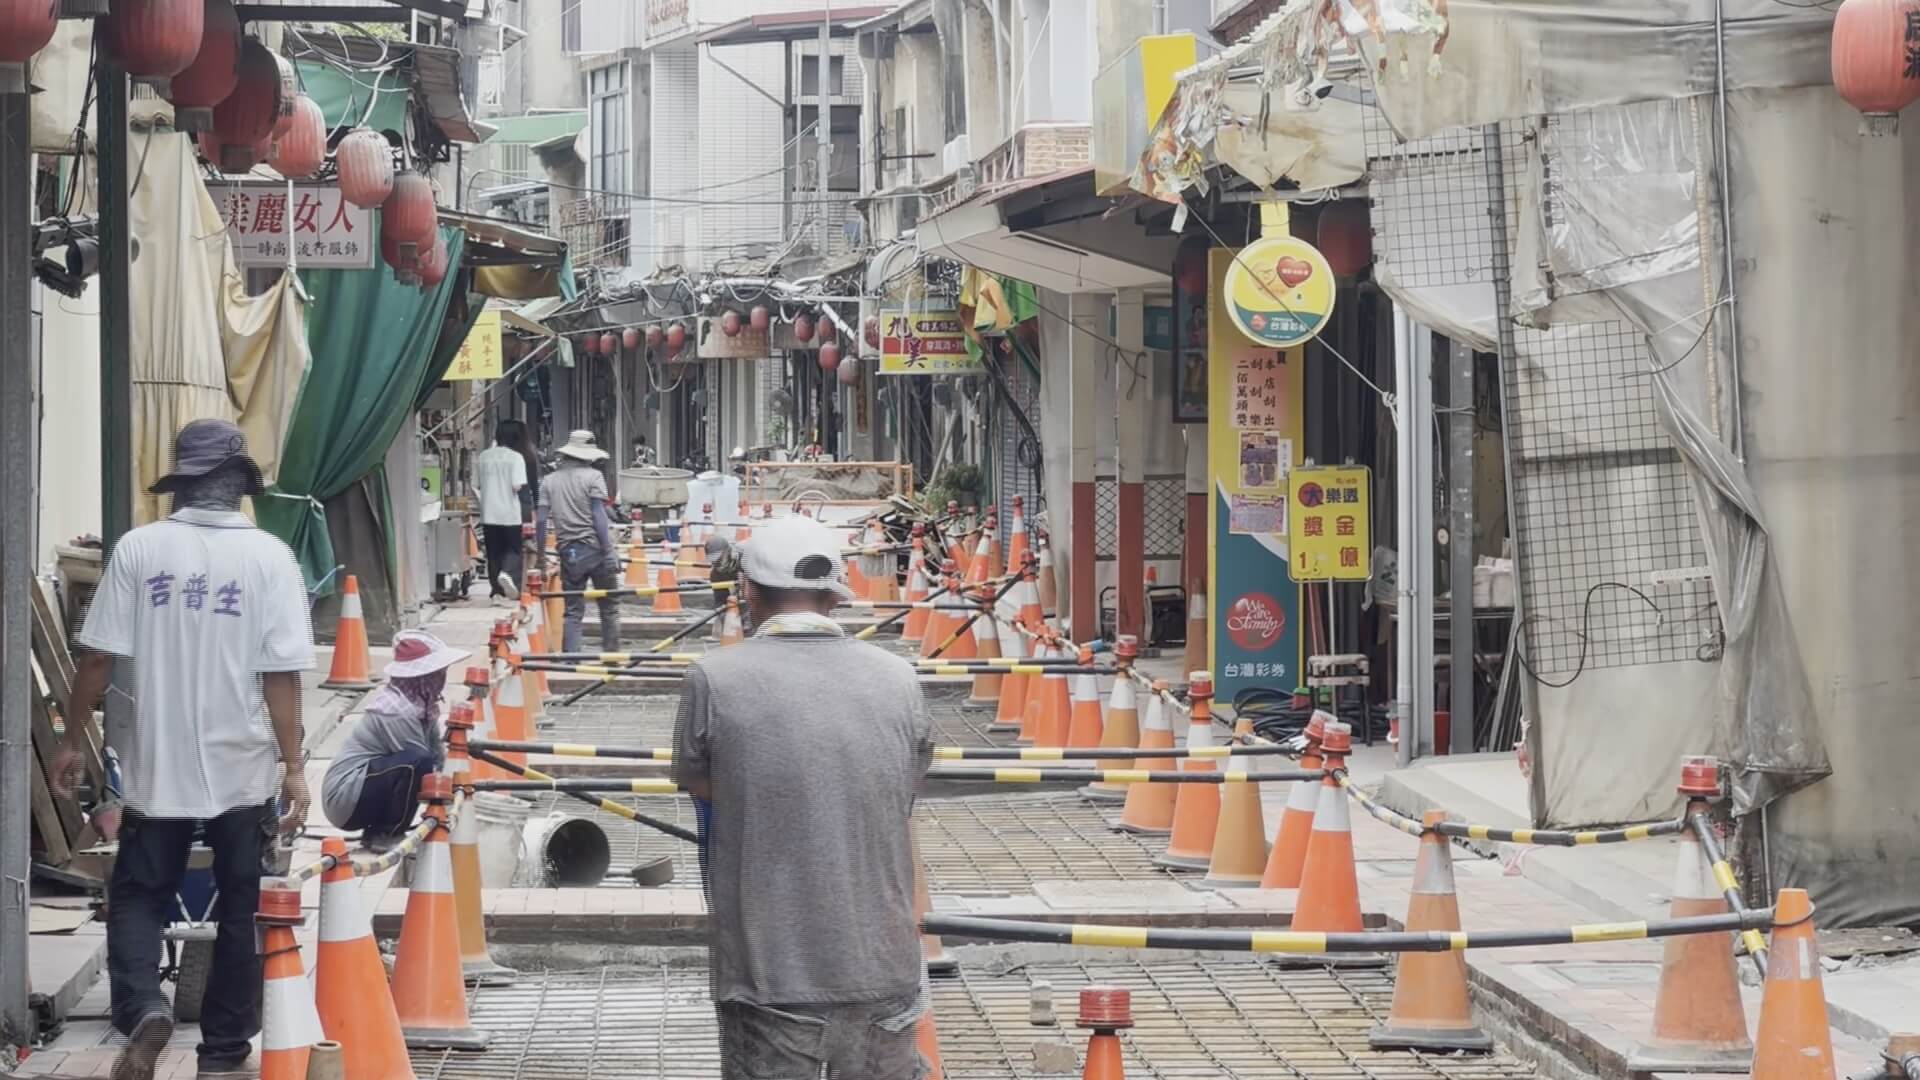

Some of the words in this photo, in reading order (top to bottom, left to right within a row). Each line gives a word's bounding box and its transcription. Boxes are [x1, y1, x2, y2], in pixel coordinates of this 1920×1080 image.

[144, 570, 242, 617] 吉普生
[1224, 662, 1285, 677] 台灣彩券
